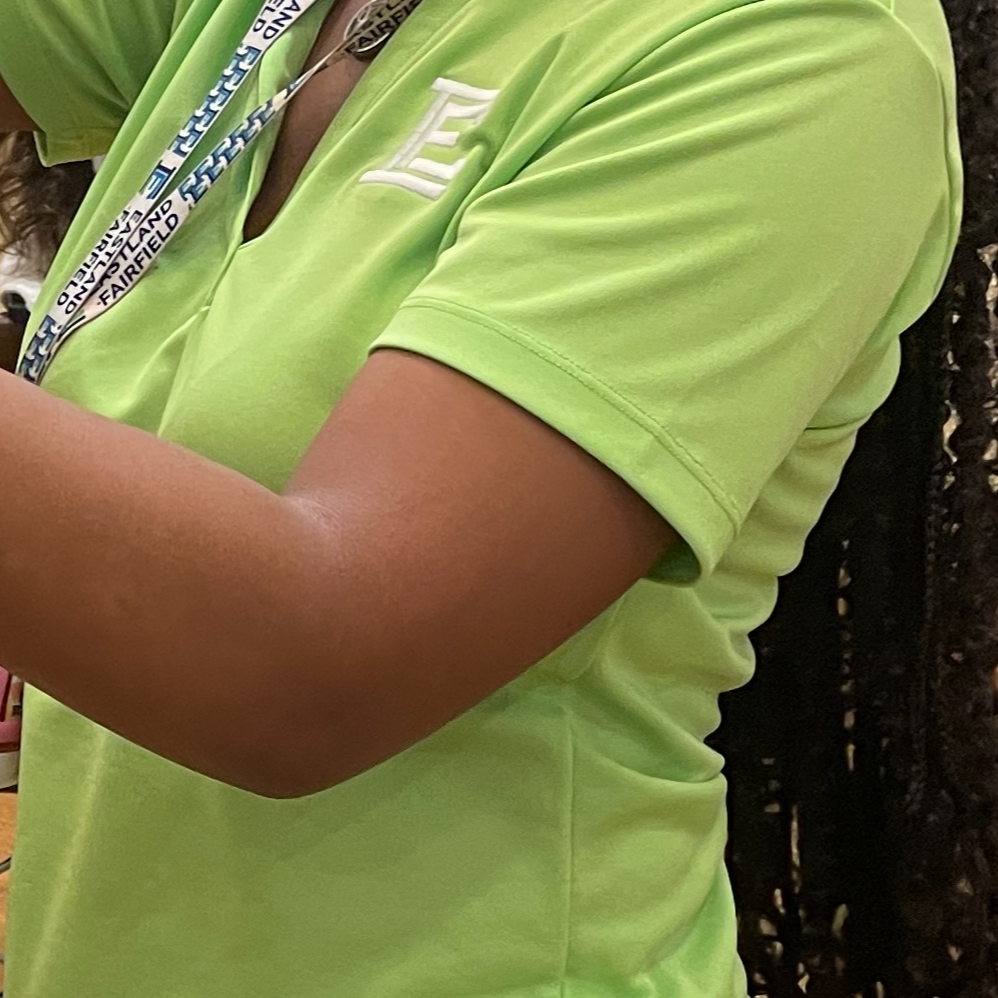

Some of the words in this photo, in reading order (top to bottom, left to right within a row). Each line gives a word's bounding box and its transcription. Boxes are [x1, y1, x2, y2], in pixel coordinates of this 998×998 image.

[57, 210, 129, 305] FAIRFIELD
[65, 210, 143, 314] EASTLAND
[88, 200, 173, 299] ASTLAND
[99, 213, 179, 306] FAIRFIELD
